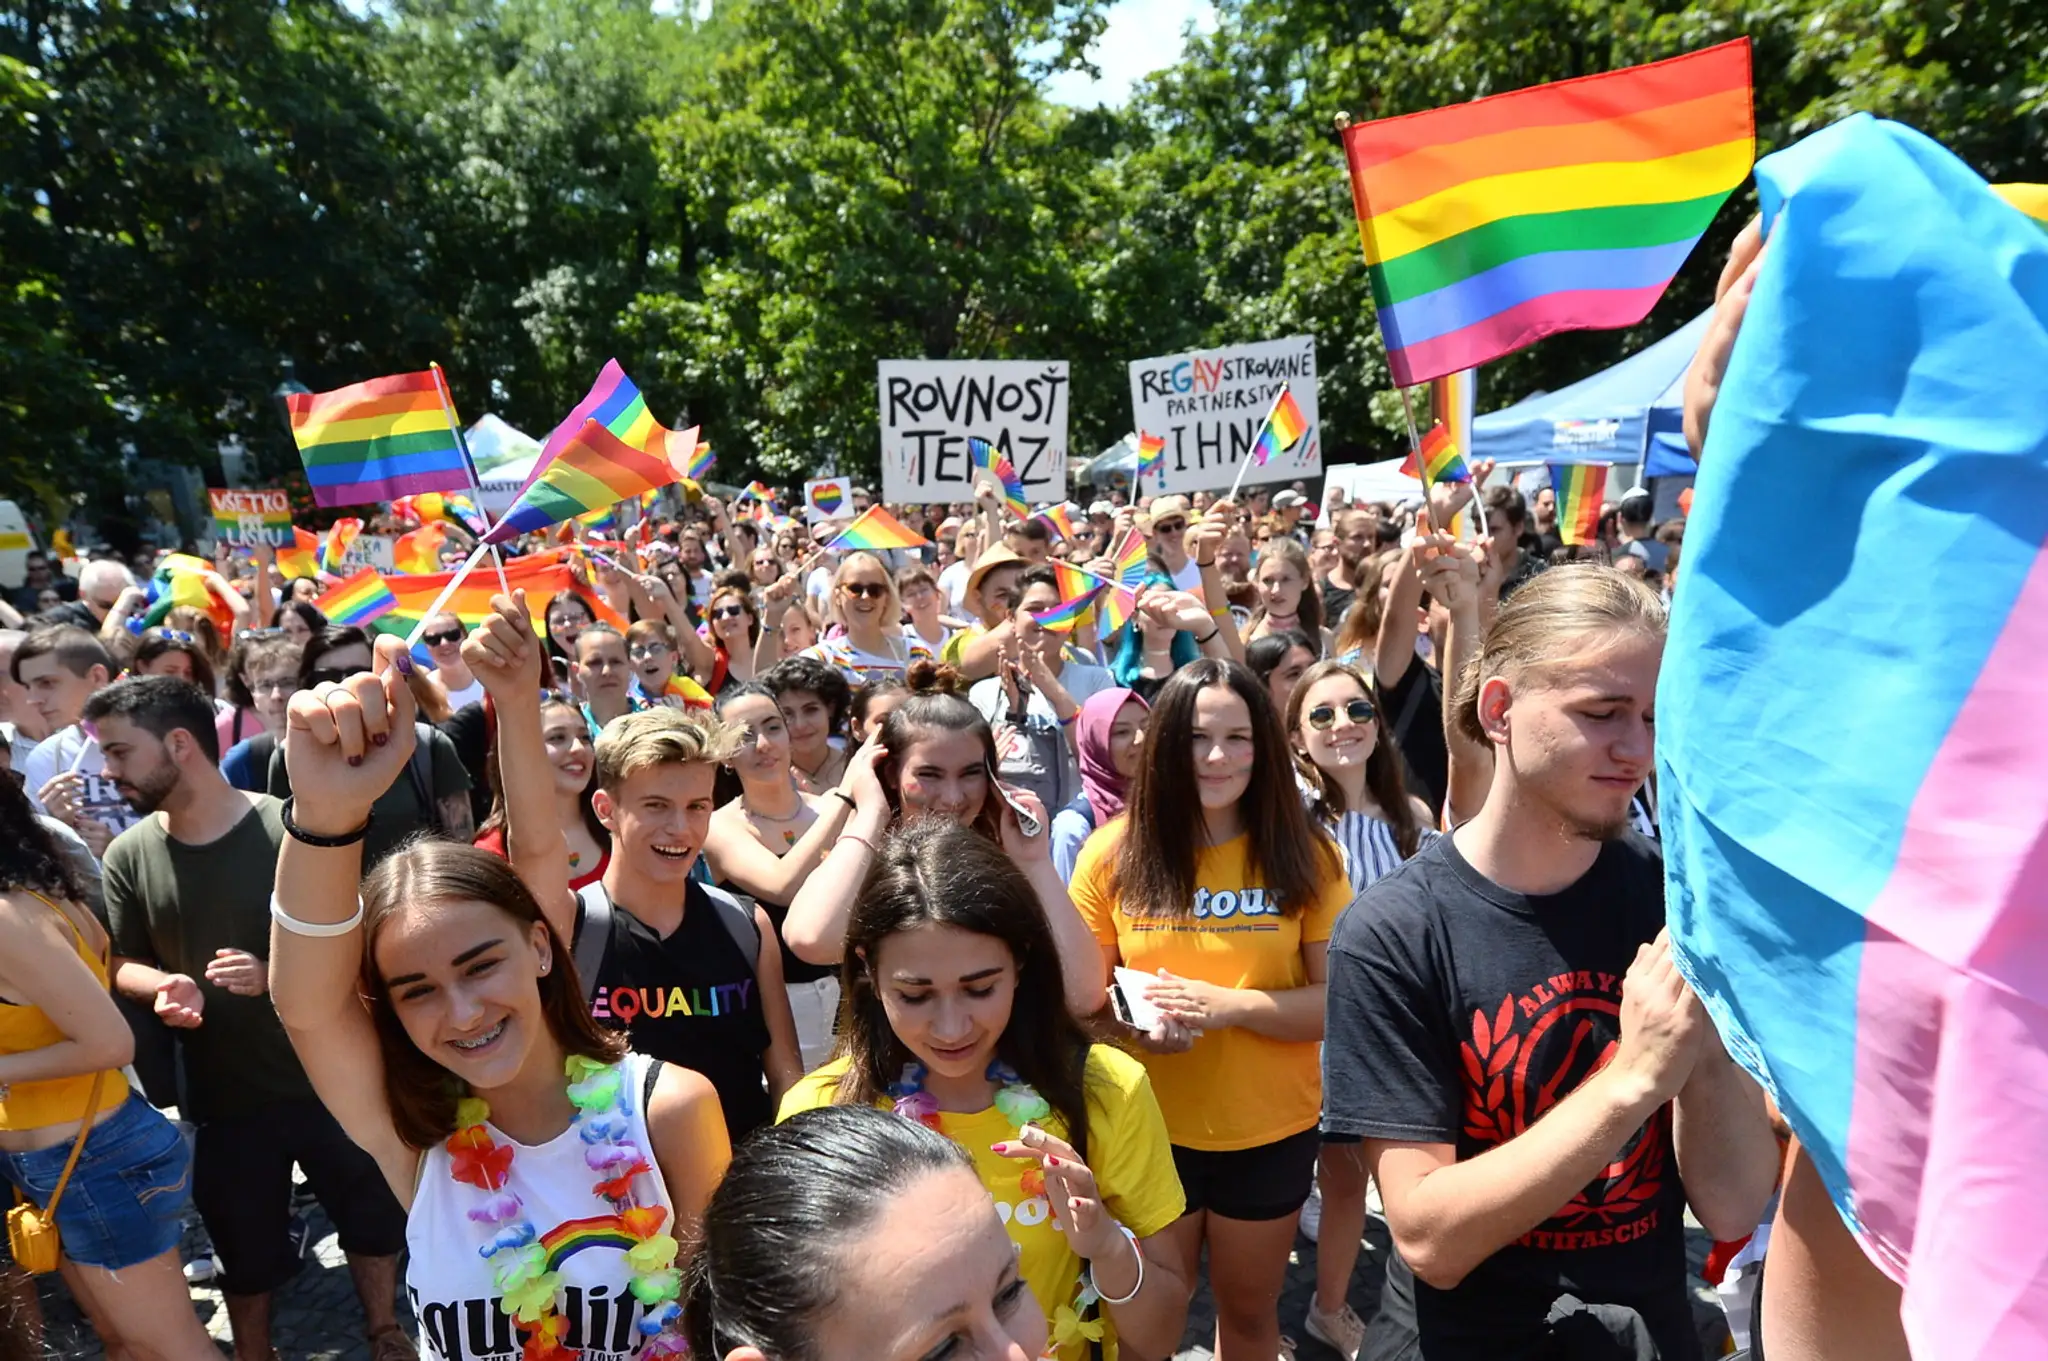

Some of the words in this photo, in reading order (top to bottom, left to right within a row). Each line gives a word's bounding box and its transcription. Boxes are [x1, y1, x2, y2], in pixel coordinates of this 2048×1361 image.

[888, 366, 1067, 427] ROVNOSŤ
[1140, 342, 1312, 402] REGAYSTROVANÉ
[591, 979, 752, 1024] EQUALITY
